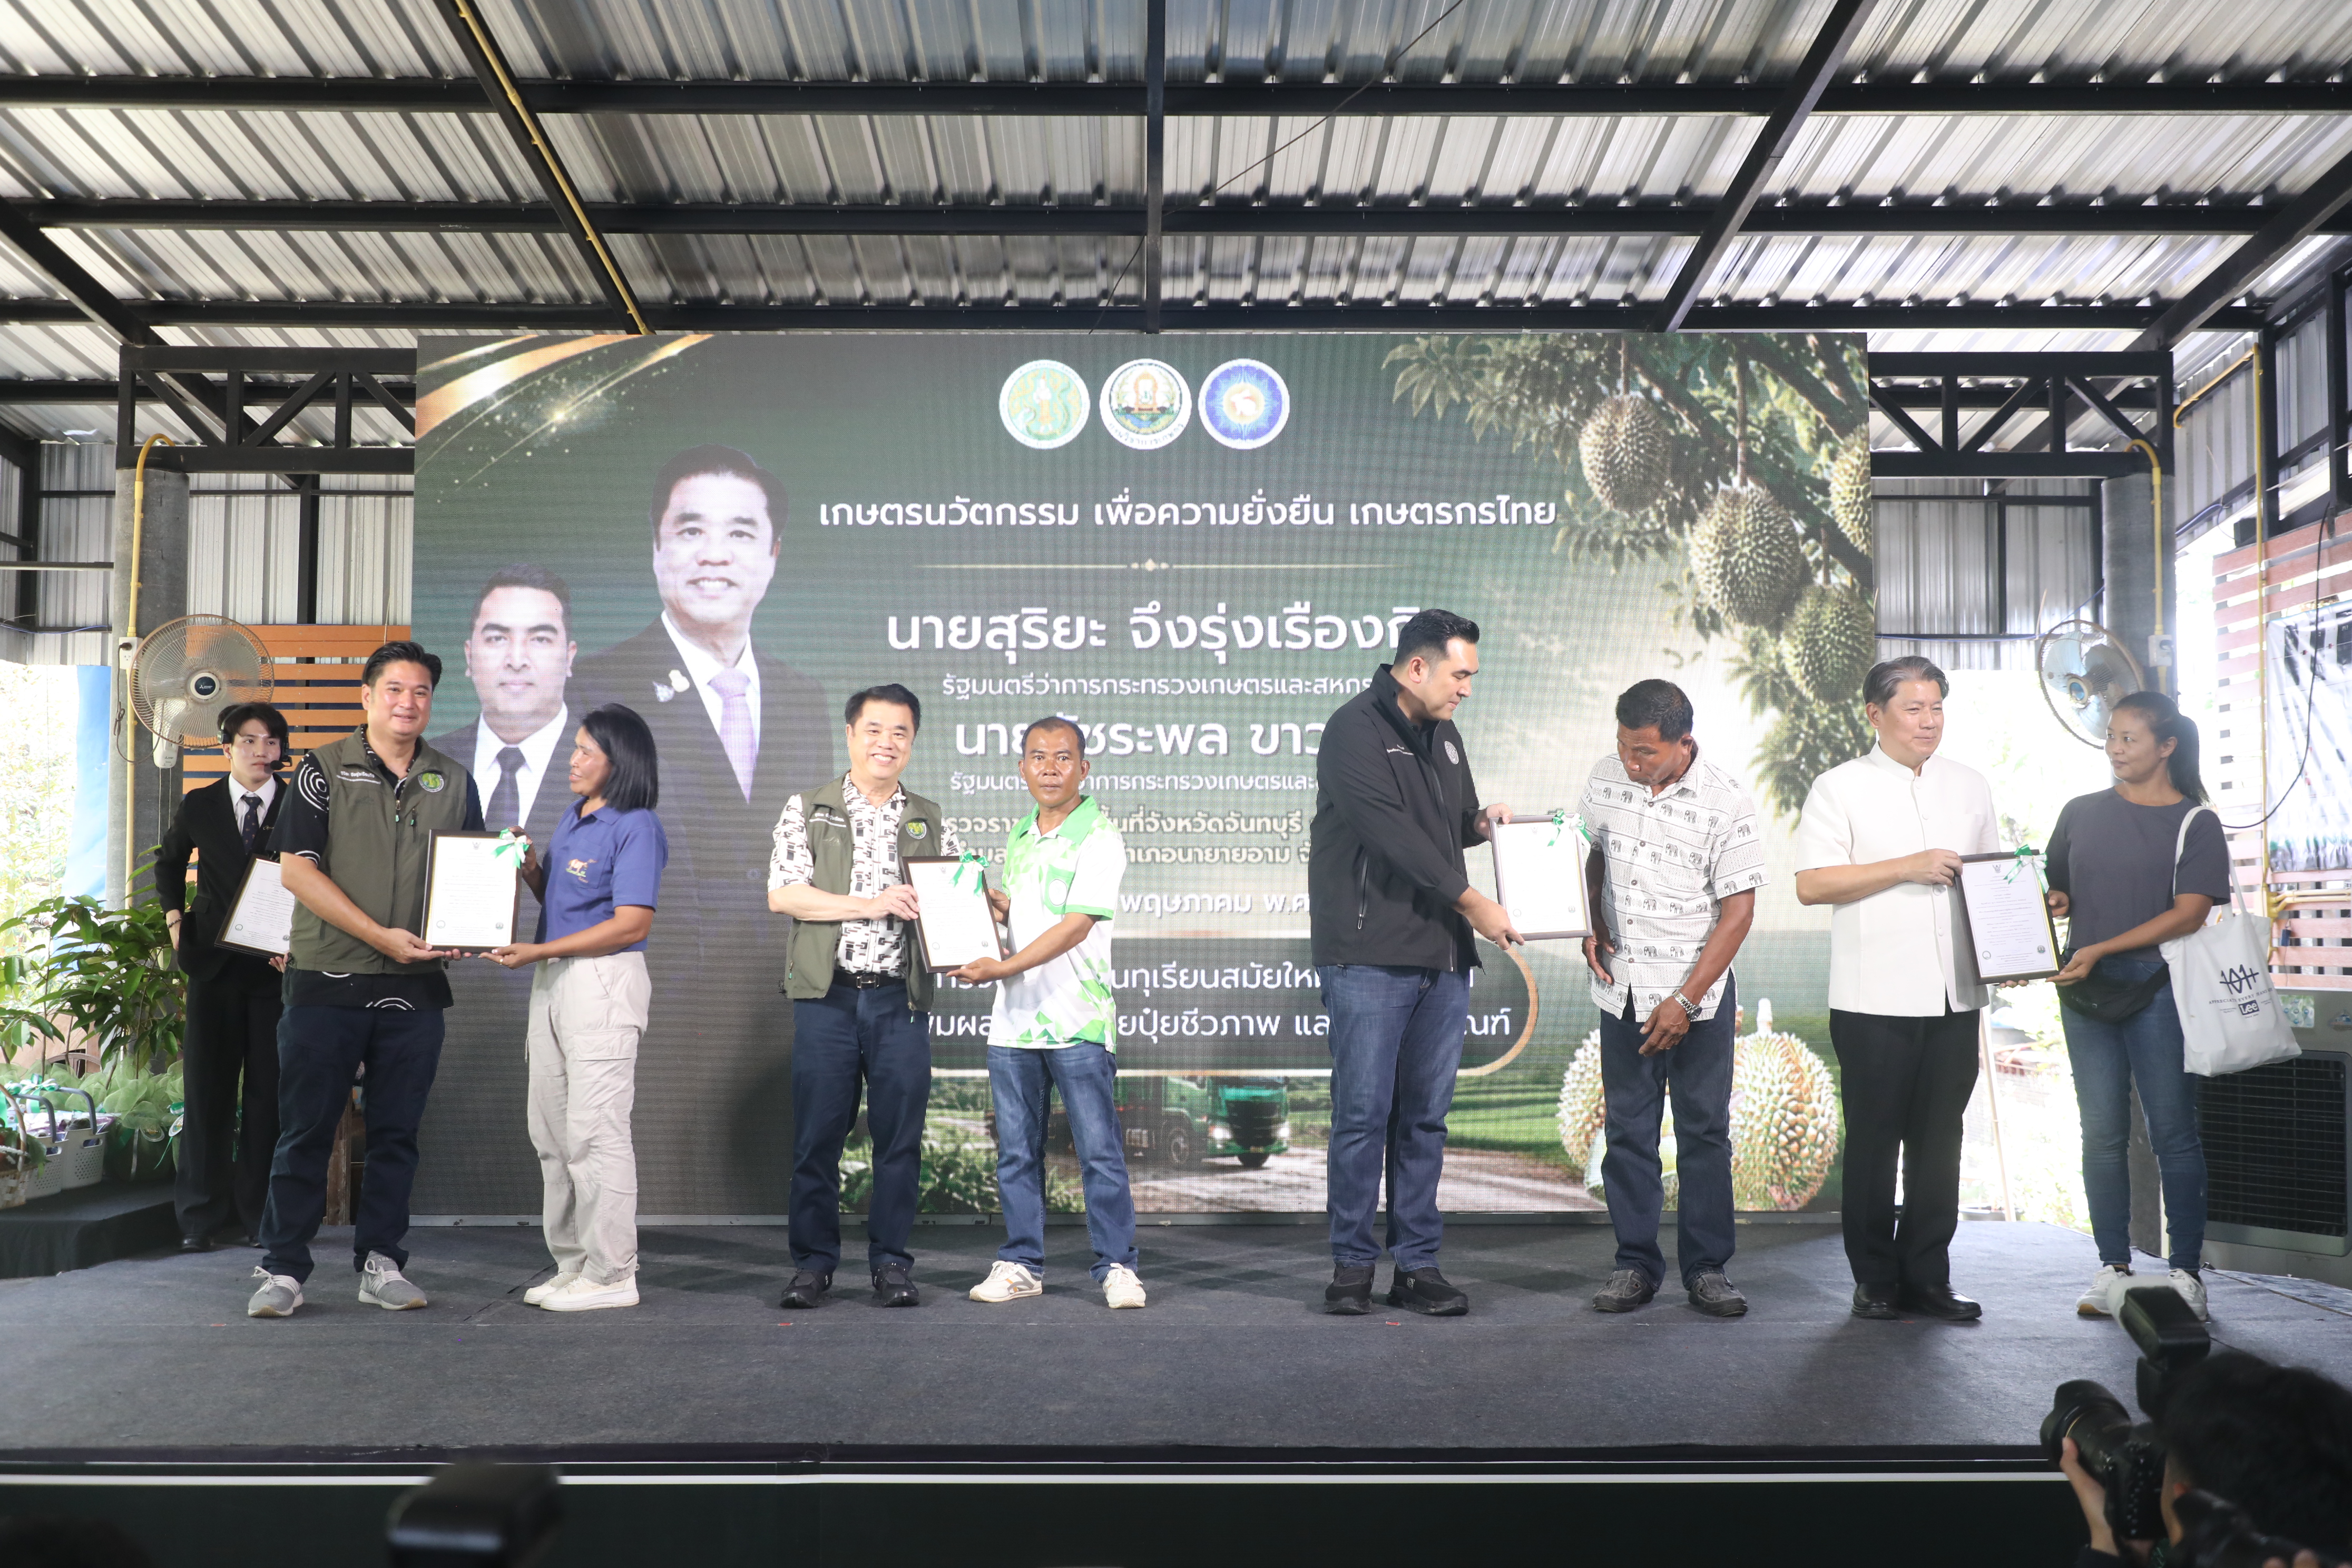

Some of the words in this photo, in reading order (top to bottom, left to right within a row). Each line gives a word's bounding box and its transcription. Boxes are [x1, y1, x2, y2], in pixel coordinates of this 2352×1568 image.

[820, 495, 1079, 525] เกษตรนวัตกรรม
[1094, 487, 1334, 525] เพื่อความยั่งยืน
[1350, 494, 1556, 525] เกษตรกรไทย
[888, 607, 1106, 664] นายสุริยะ
[943, 672, 1373, 700] รัฐมนตรีว่าการกระทรวงเกษตรและสหกร
[1121, 893, 1252, 918] พฤษภาคม
[2239, 1002, 2258, 1014] Lee
